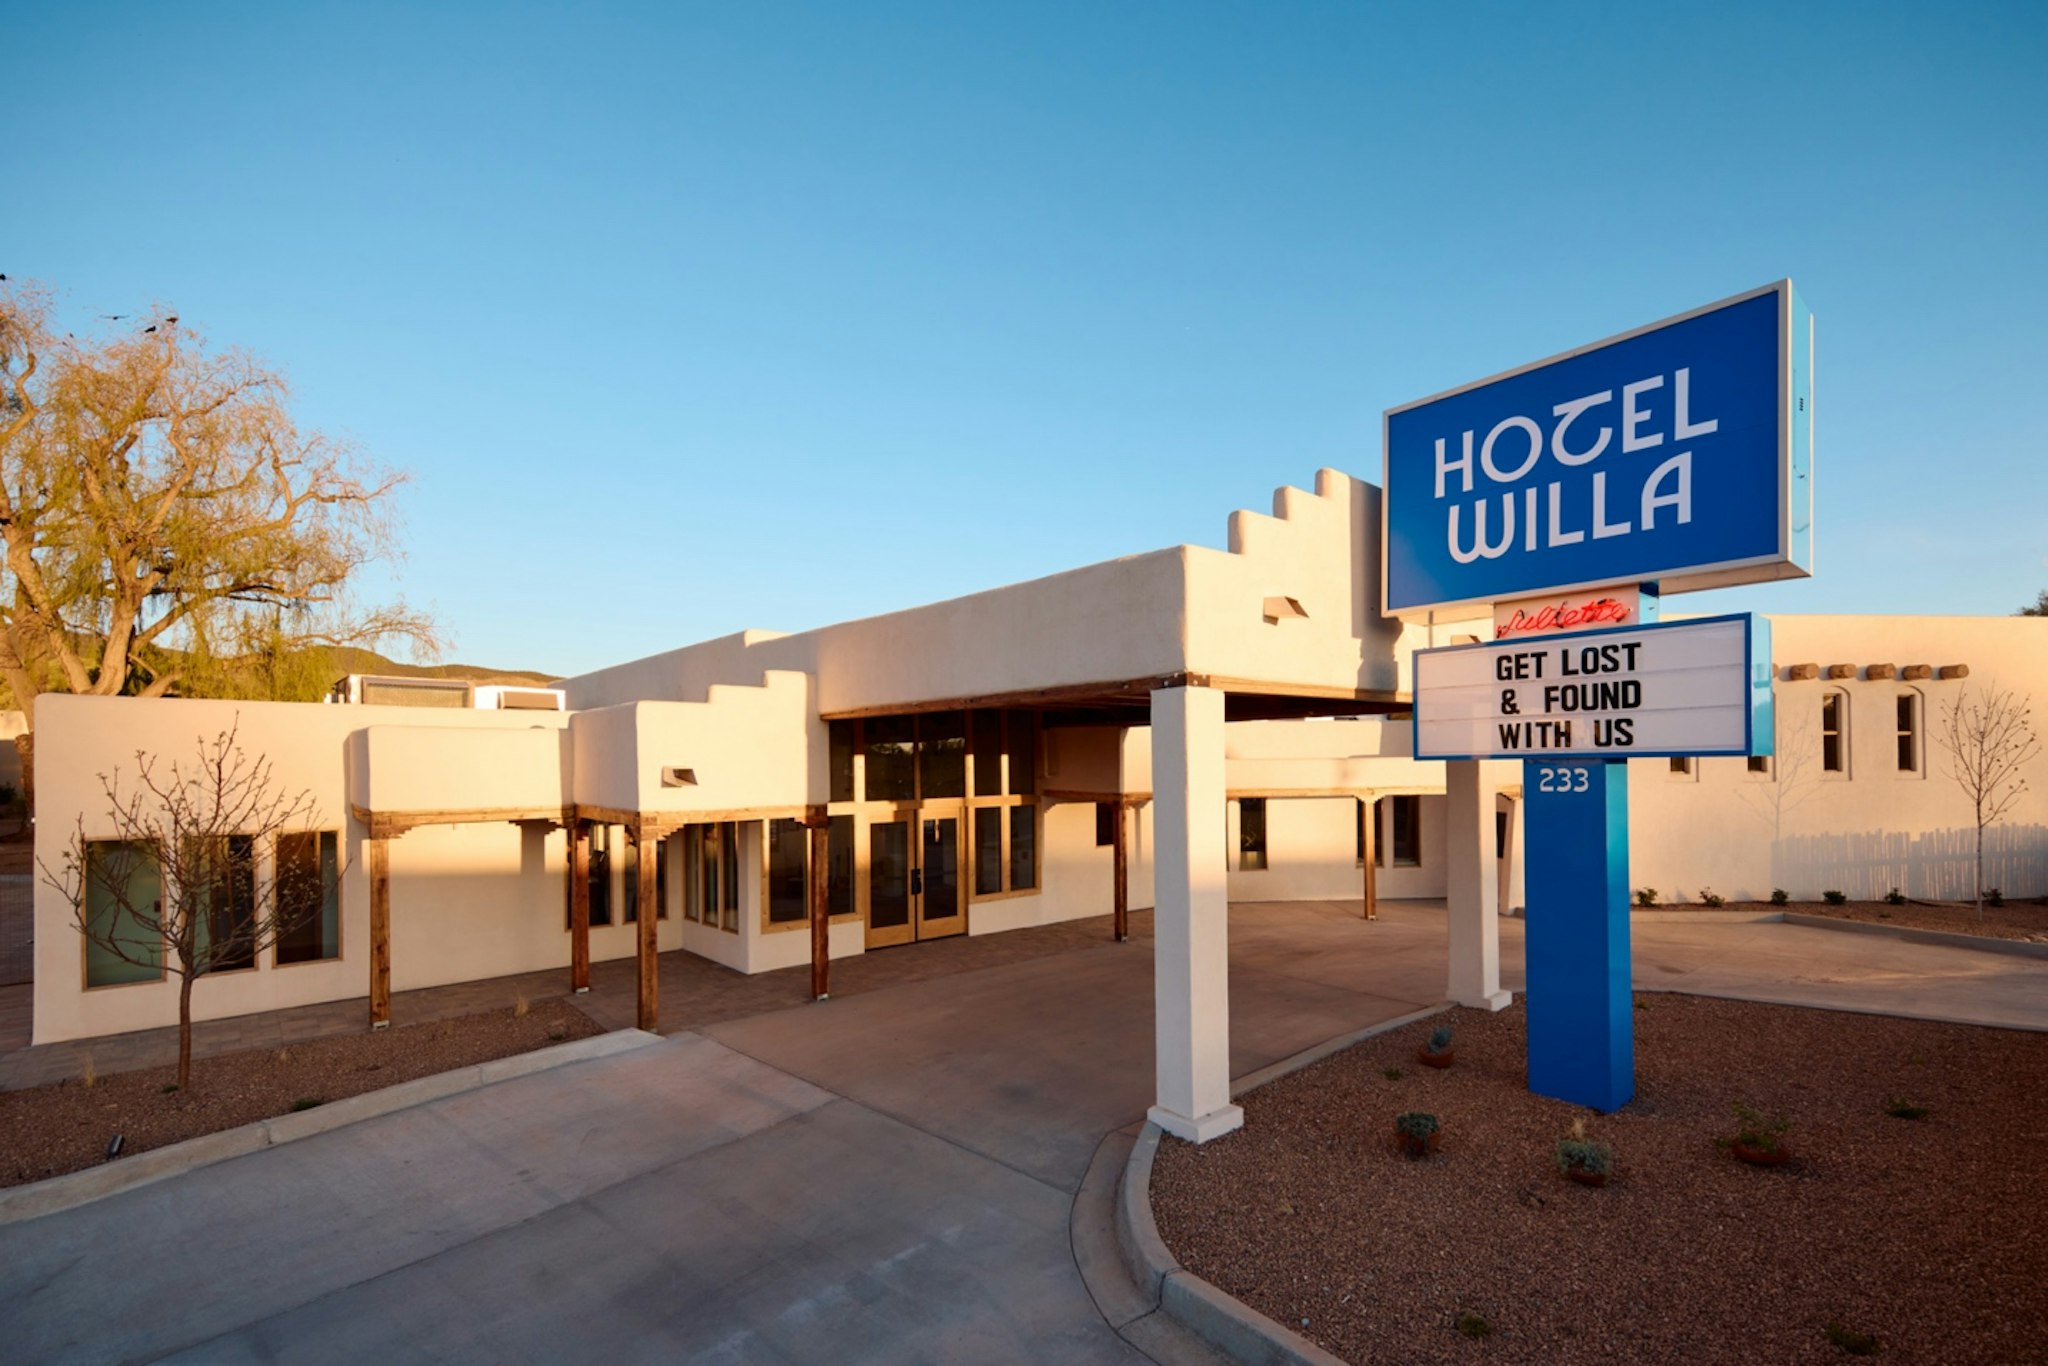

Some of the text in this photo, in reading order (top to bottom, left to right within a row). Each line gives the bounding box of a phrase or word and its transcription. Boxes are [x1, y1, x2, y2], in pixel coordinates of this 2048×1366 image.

[1434, 367, 1718, 499] HOTEL
[1447, 451, 1692, 564] WILLA
[1496, 598, 1631, 638] Juliette
[1496, 642, 1642, 681] GET LOST
[1501, 680, 1642, 715] & FOUND
[1498, 718, 1634, 749] WITH US
[1539, 768, 1589, 792] 233
